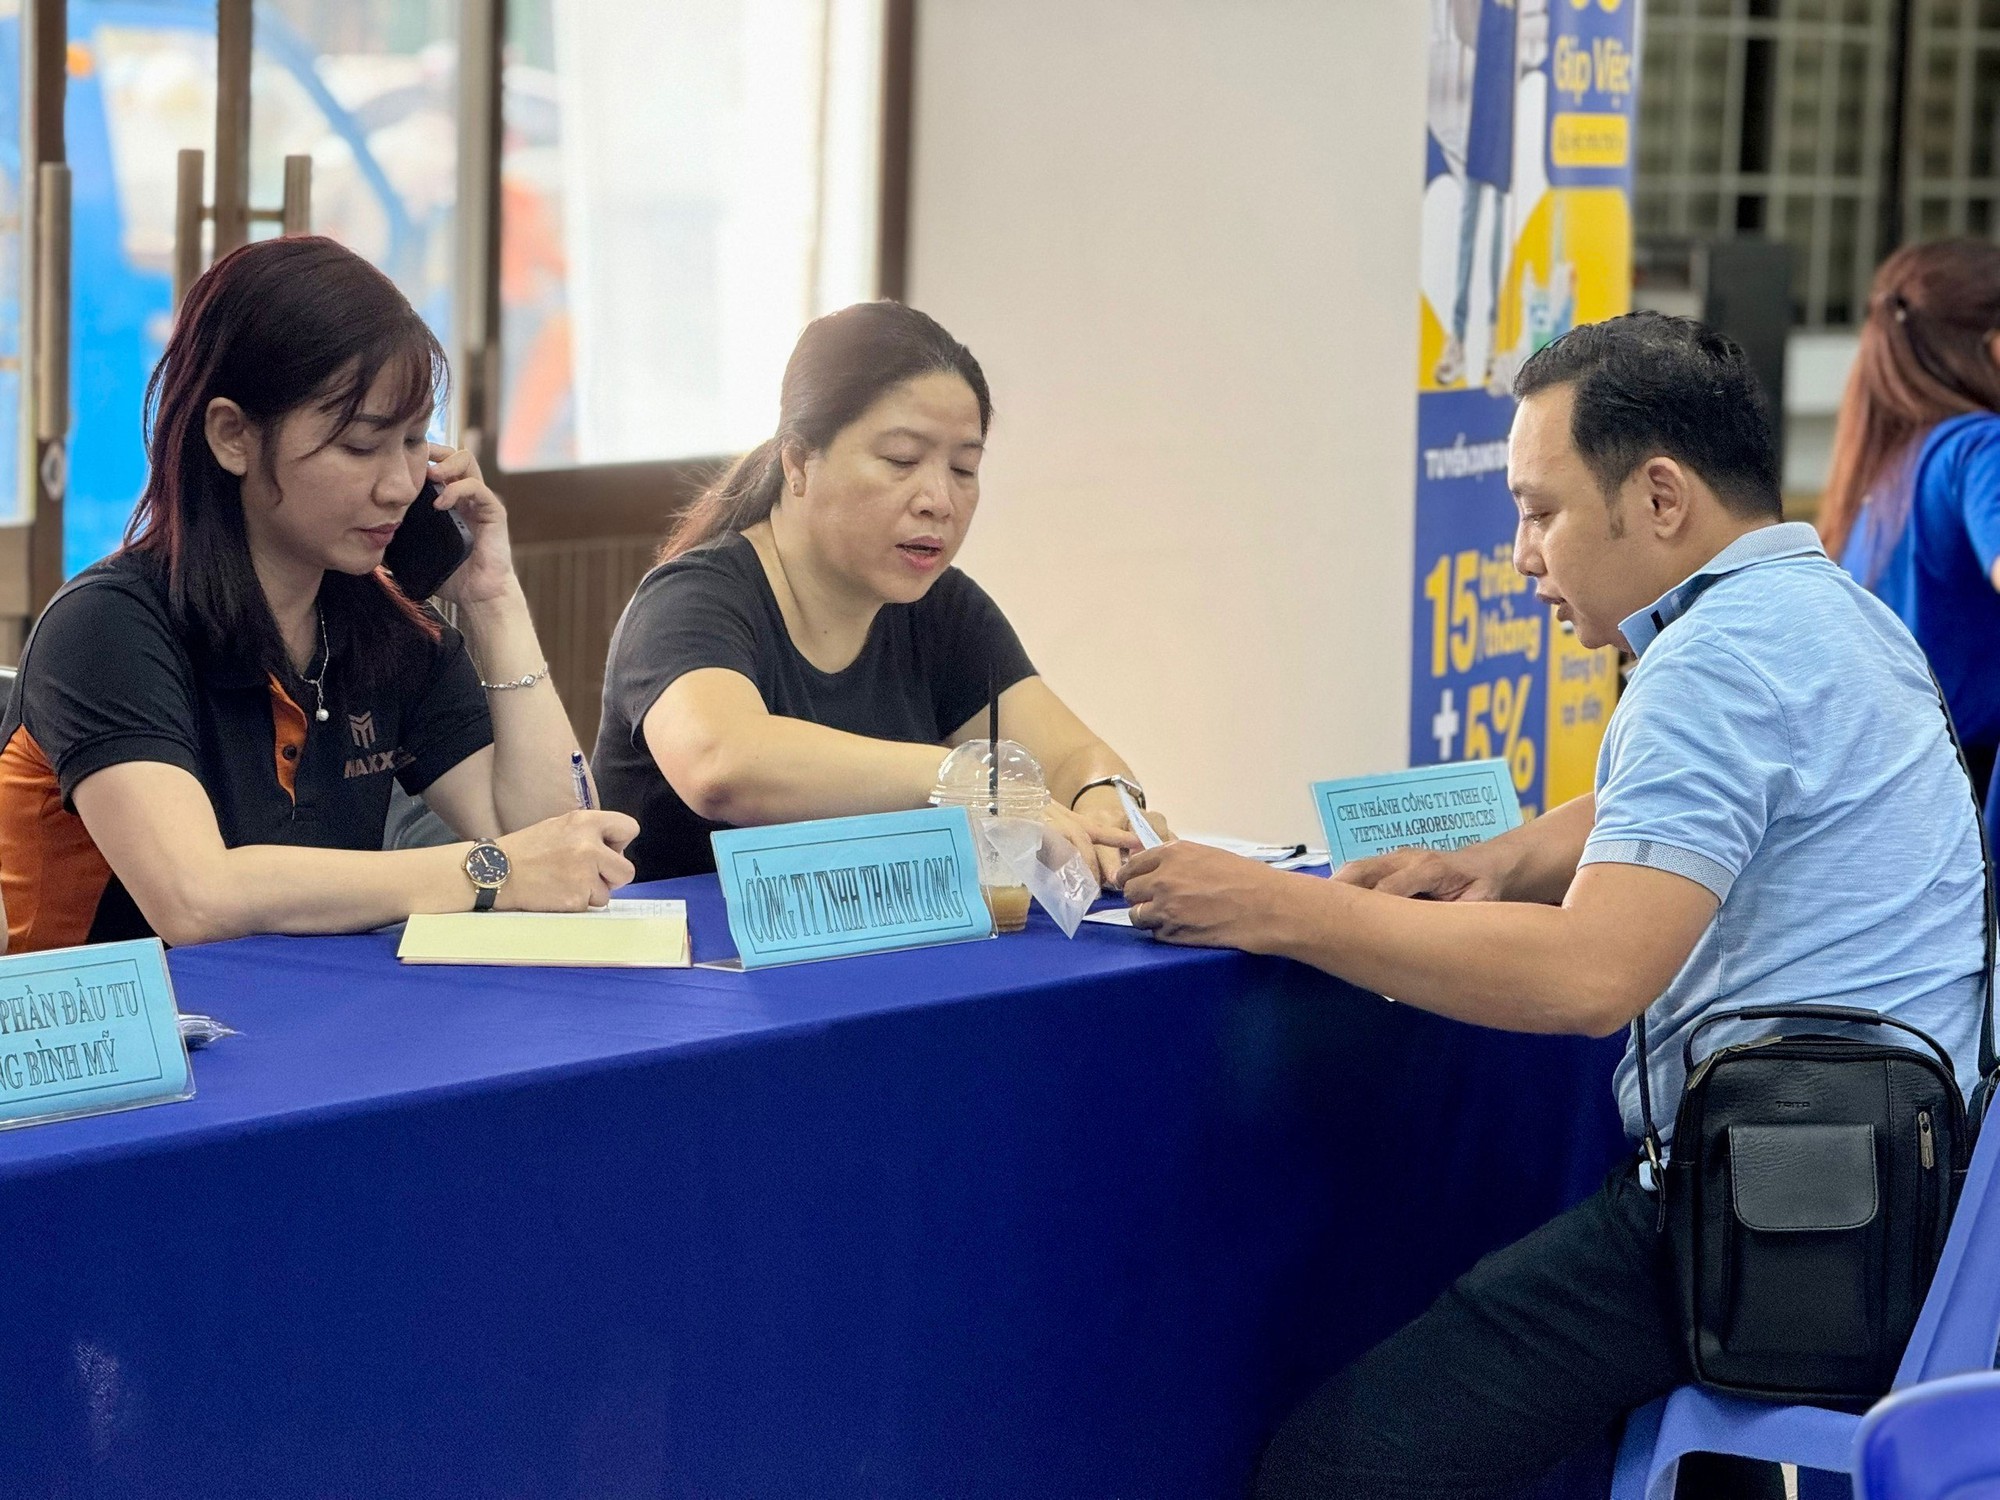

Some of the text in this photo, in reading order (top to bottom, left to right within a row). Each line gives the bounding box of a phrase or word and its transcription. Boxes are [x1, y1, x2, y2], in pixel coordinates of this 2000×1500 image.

[1425, 550, 1480, 678] 15
[1337, 786, 1497, 821] CHI NHÁNH CÔNG TY TNHH QL
[1349, 821, 1404, 843] VIETNAM
[1405, 809, 1496, 836] AGRORESOURCES
[745, 855, 964, 943] CÔNG TY TNHH THANH LONG
[58, 977, 106, 1025] ĐẦU
[23, 1039, 83, 1086] BÌNH
[81, 1030, 119, 1076] MỸ
